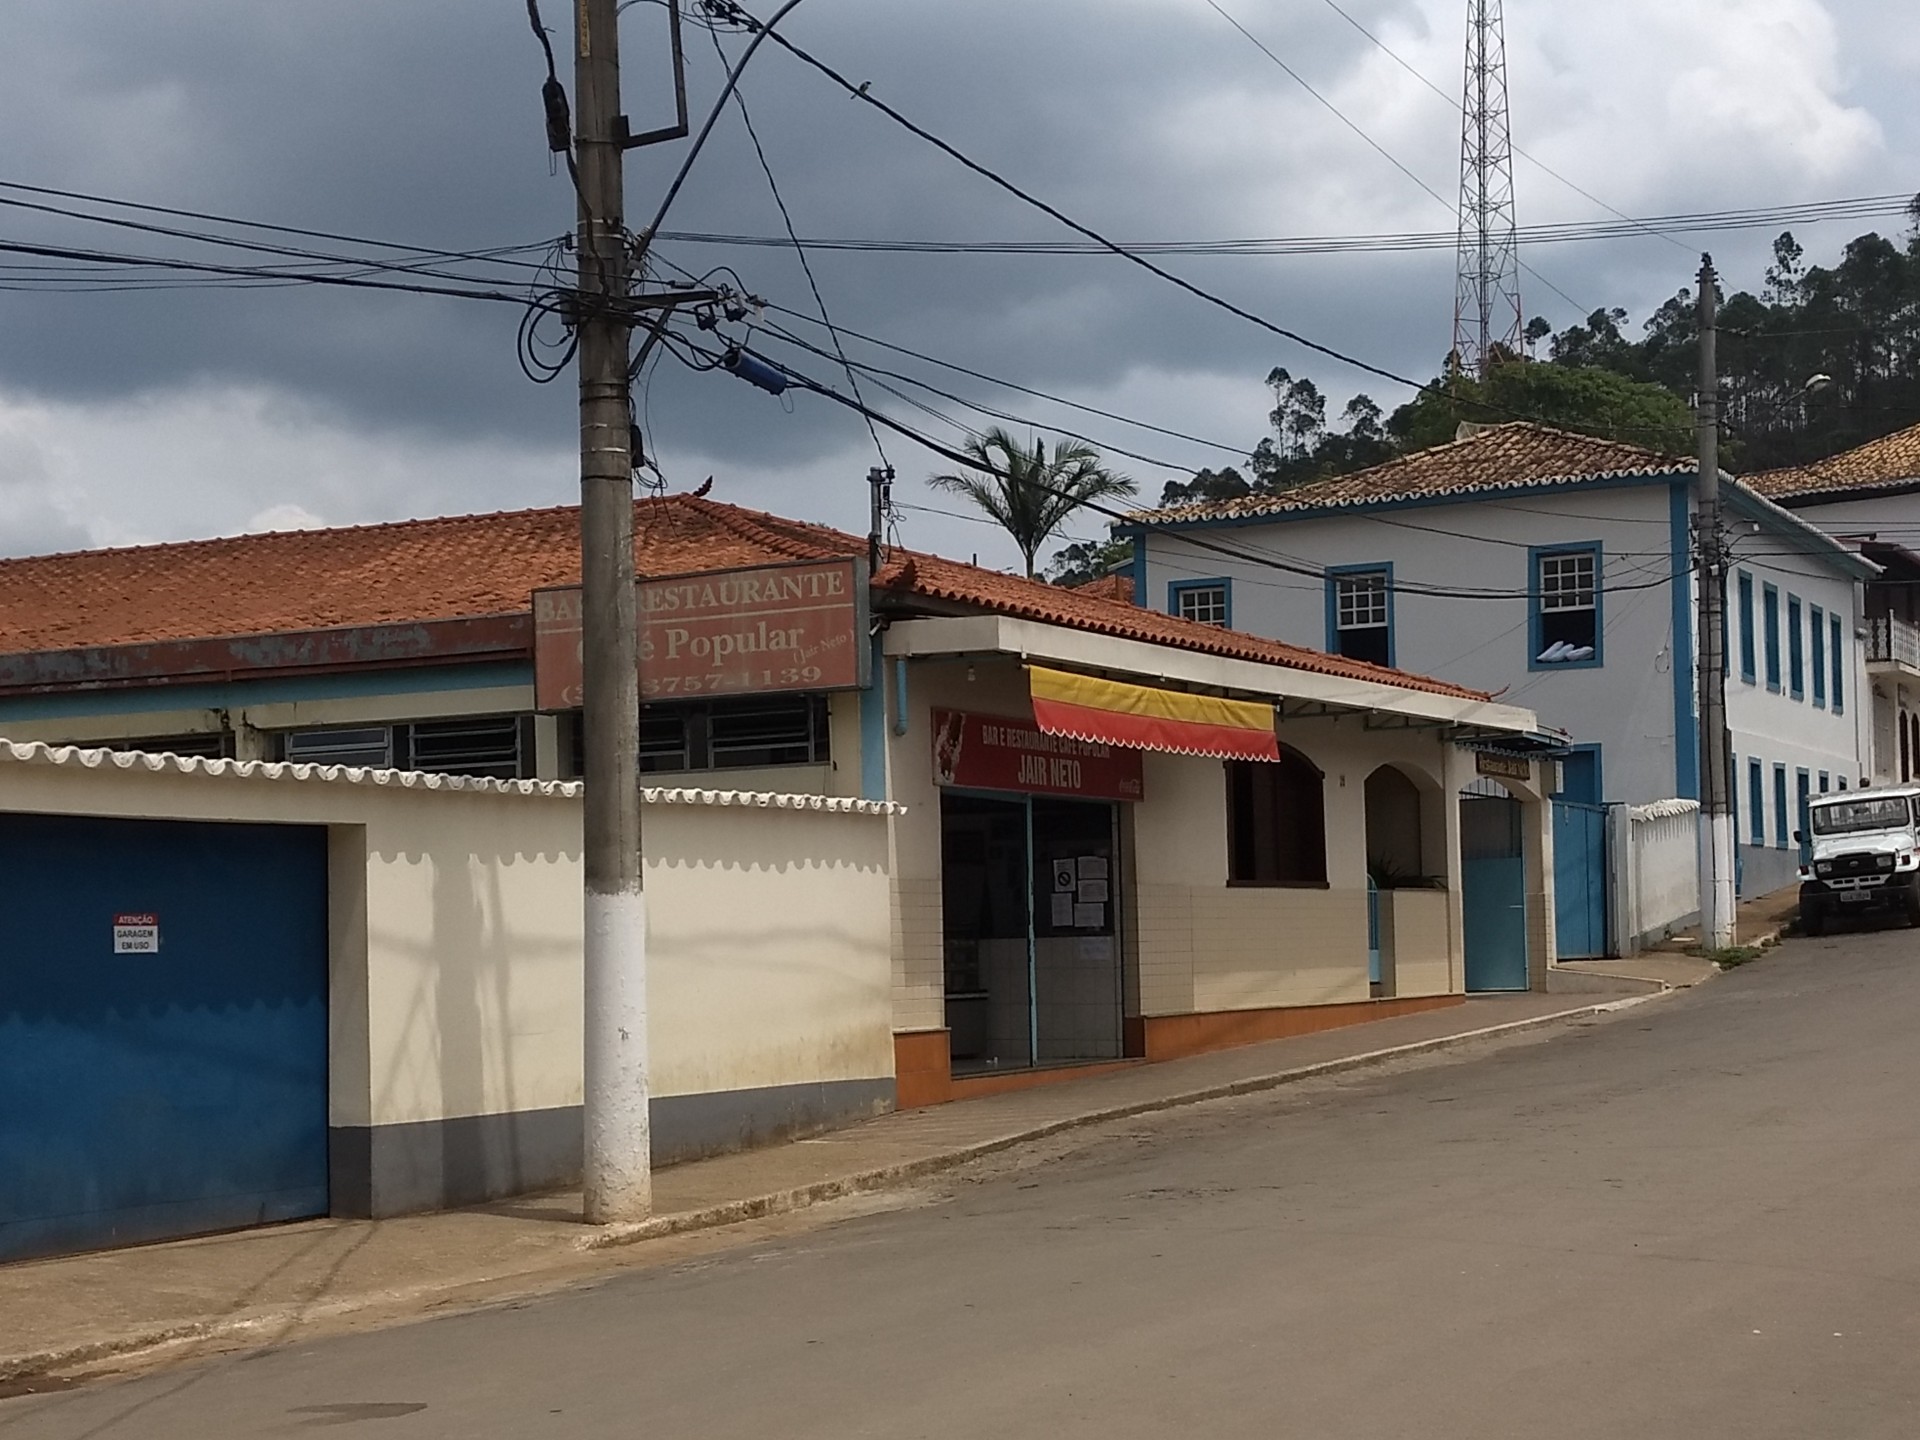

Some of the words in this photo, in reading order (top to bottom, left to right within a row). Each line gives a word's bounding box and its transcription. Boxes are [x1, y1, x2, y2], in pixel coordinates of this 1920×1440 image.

[664, 621, 805, 667] Popular
[982, 724, 999, 745] BAR
[1000, 728, 1005, 746] E
[1017, 754, 1048, 785] JAIR
[1049, 758, 1082, 789] NETO
[118, 915, 153, 925] ATENÇÃO
[117, 929, 154, 938] GARAGEM
[122, 941, 133, 950] EM
[134, 941, 149, 950] USO
